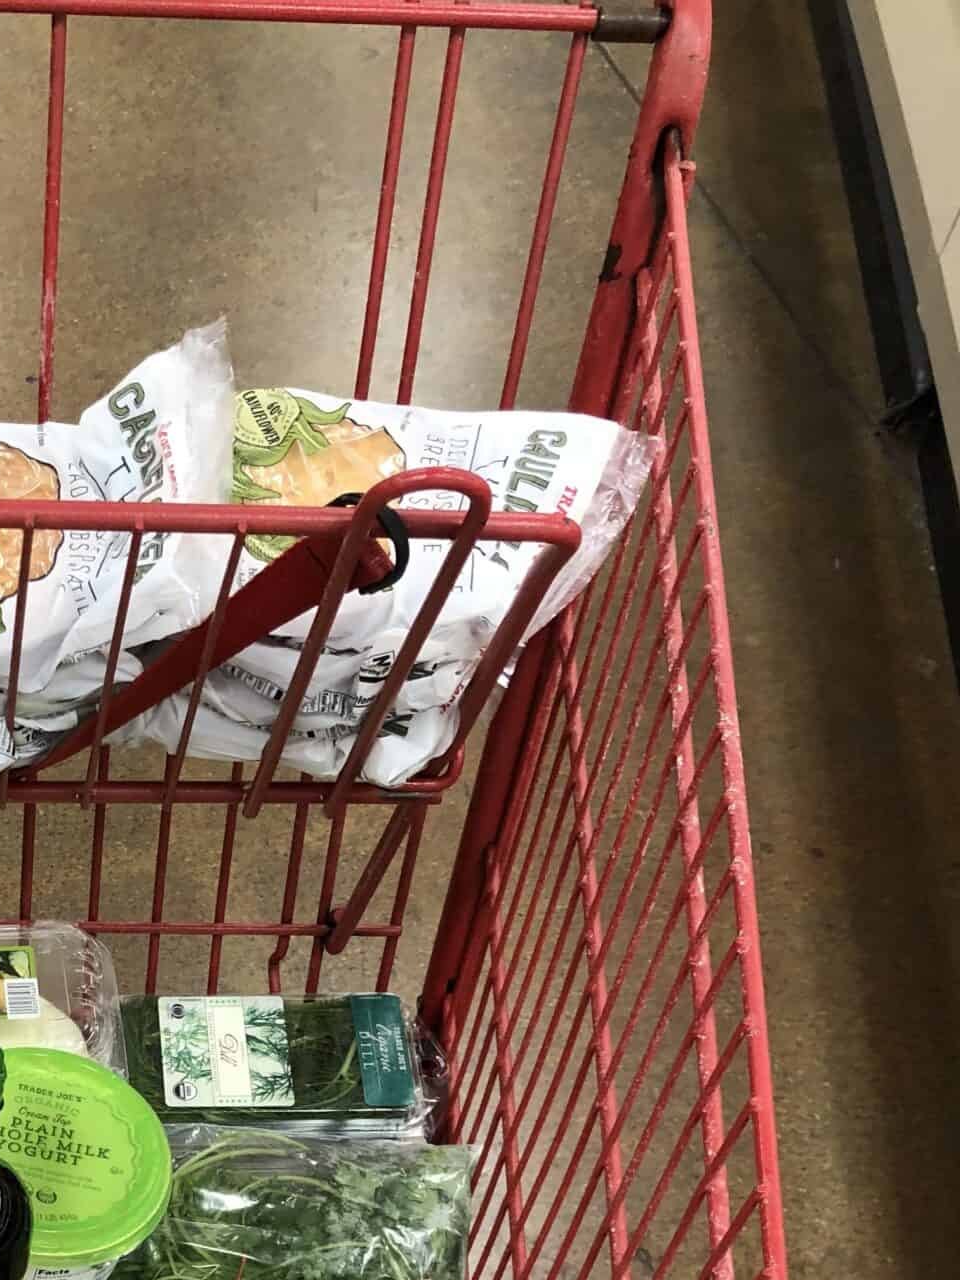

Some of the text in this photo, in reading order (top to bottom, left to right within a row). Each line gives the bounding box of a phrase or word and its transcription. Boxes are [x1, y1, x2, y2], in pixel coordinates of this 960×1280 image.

[242, 391, 280, 444] CAULIFLOWER
[18, 1083, 82, 1102] TRADER JOE'S
[15, 1096, 80, 1116] ORGANIC
[19, 1106, 71, 1125] Cream Top
[11, 1116, 75, 1139] PLAIN
[56, 1140, 111, 1159] MILK
